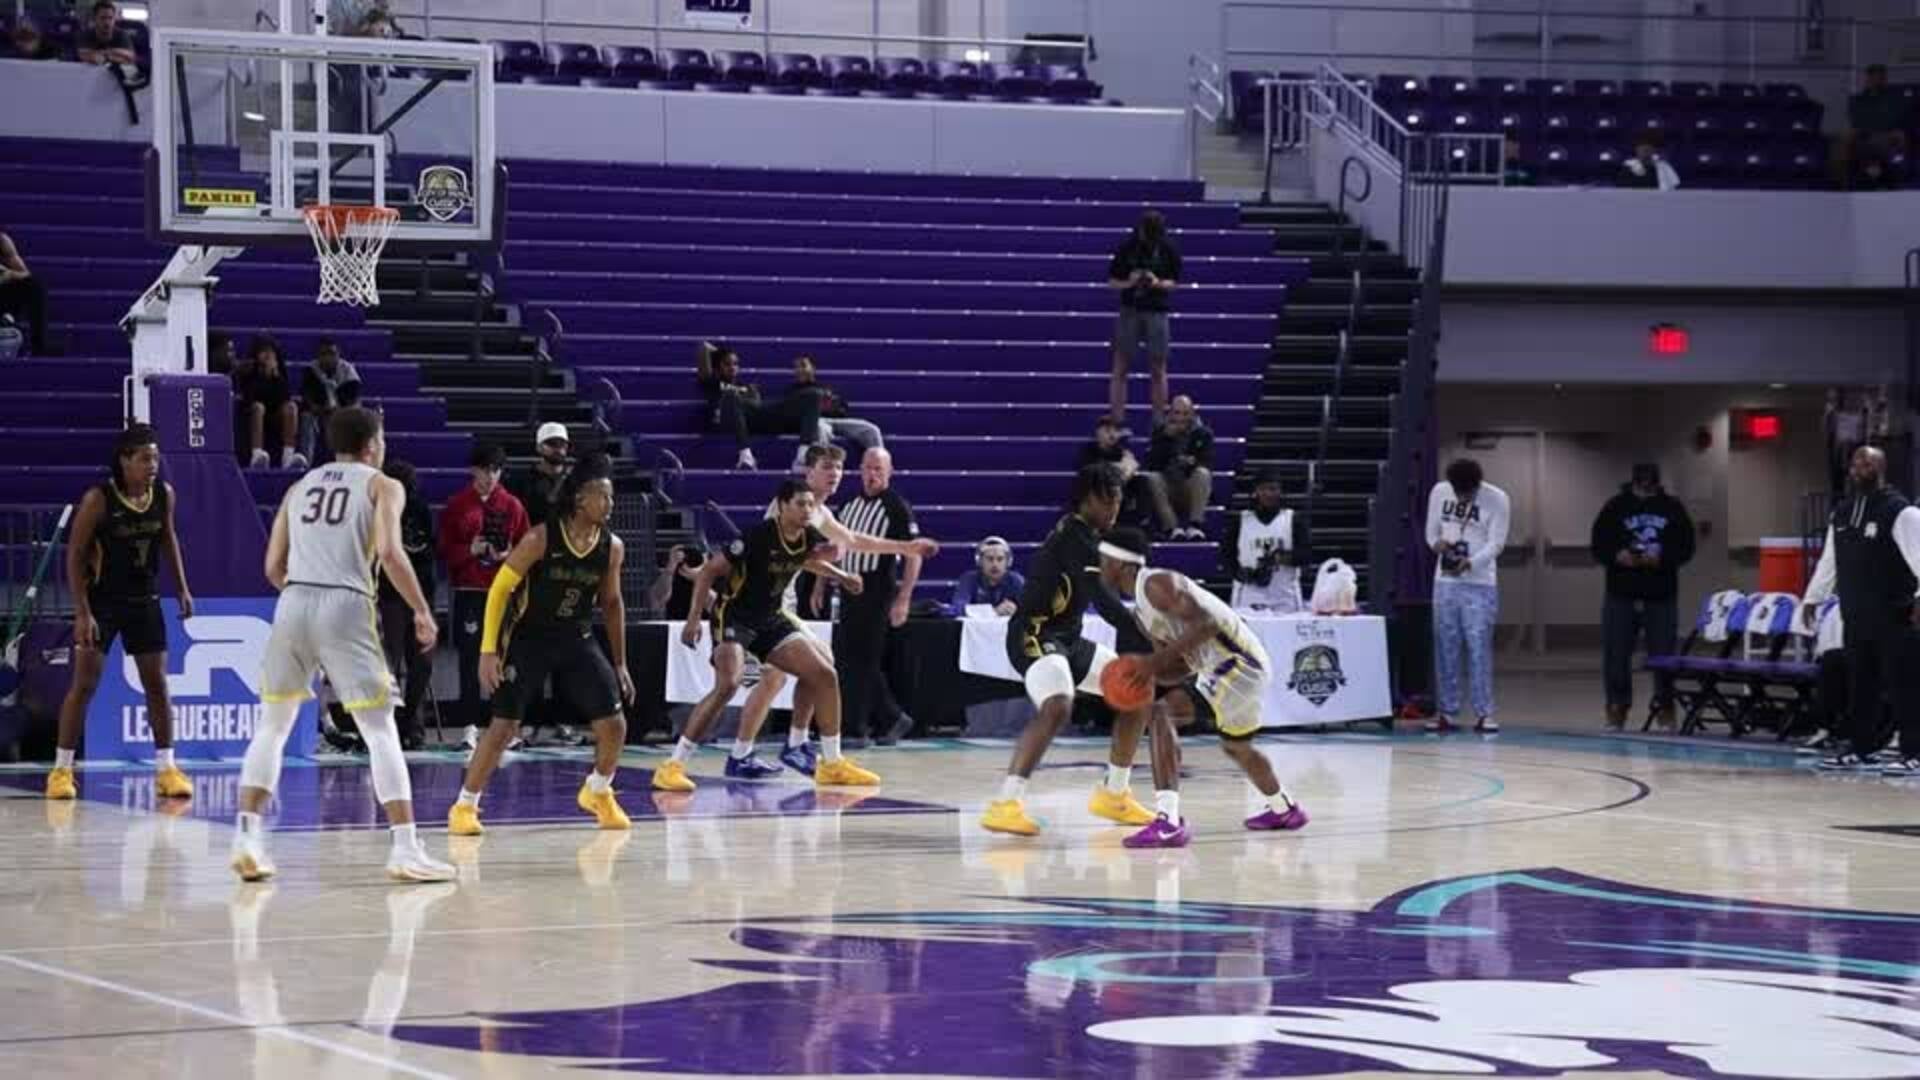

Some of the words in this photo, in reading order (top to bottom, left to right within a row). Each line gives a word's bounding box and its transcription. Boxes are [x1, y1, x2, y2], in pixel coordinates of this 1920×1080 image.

[189, 191, 251, 203] PANINI
[301, 486, 351, 526] 30
[1442, 499, 1481, 522] USA
[556, 587, 581, 617] 2
